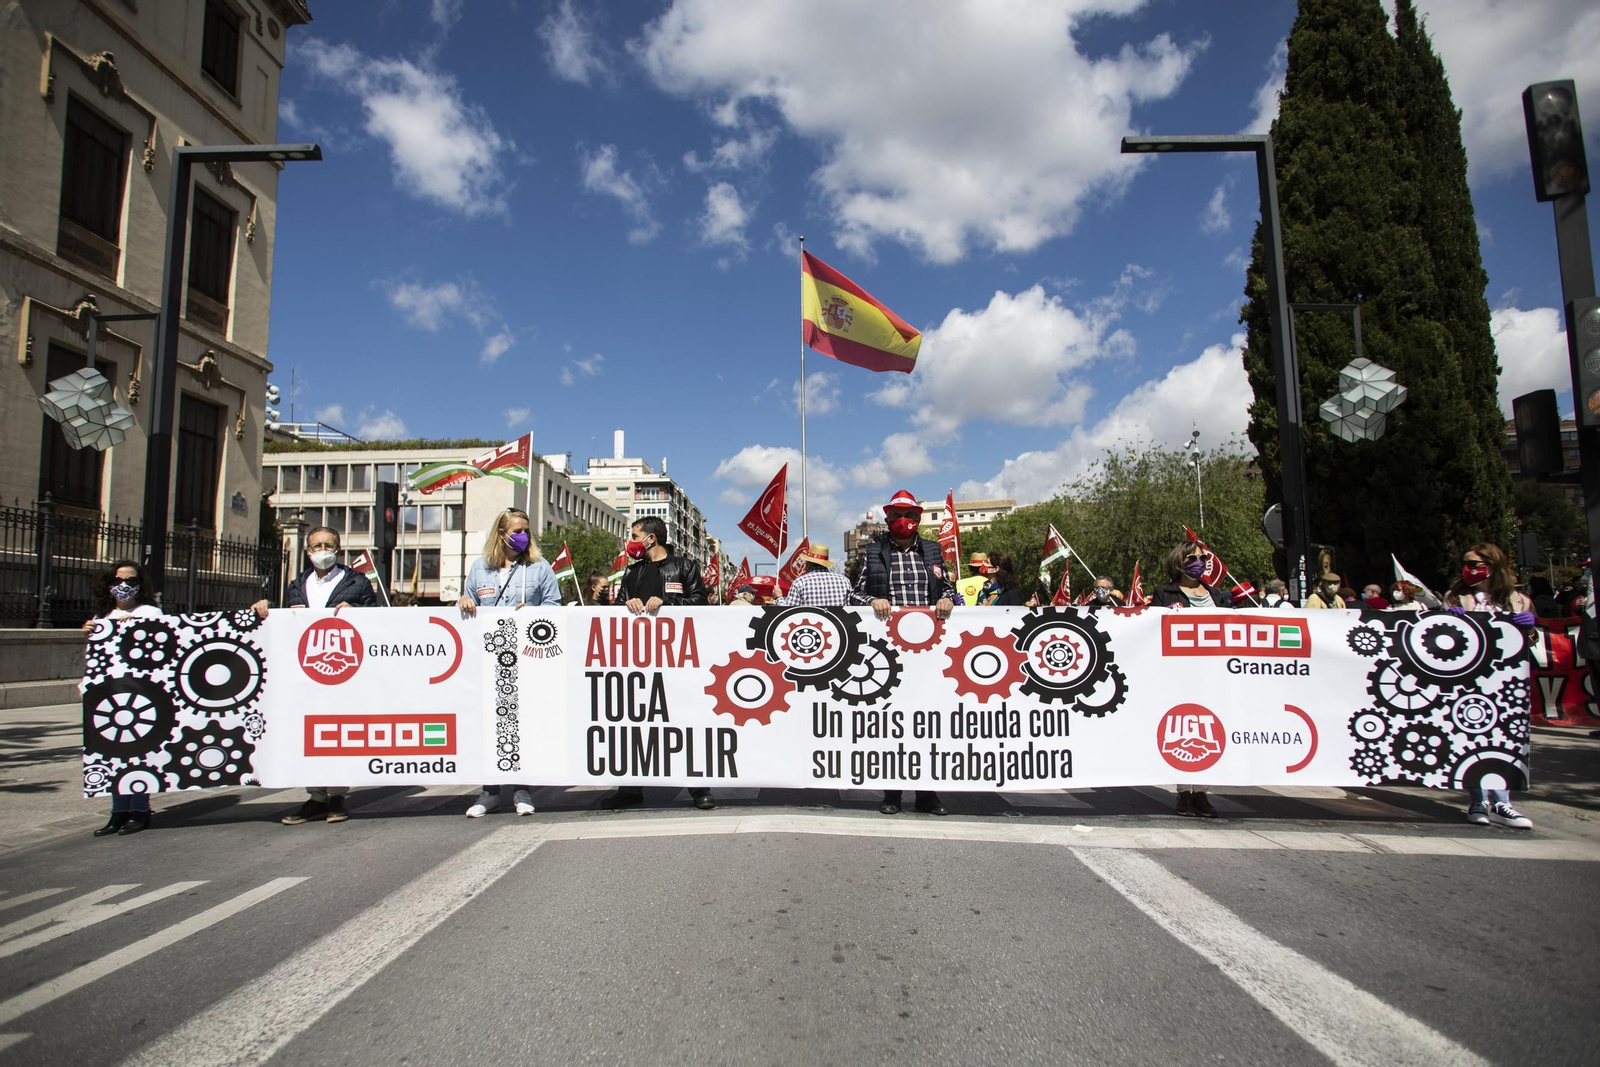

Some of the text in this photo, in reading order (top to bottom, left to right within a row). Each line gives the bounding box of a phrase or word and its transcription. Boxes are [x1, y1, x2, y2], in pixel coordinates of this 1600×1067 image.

[306, 629, 355, 656] UGT
[585, 617, 700, 668] AHORA
[1170, 623, 1275, 648] CCOO
[368, 644, 447, 657] GRANADA
[522, 644, 563, 659] MAYO 2021
[1226, 657, 1311, 676] Granada
[585, 671, 670, 722] TOCA
[314, 723, 420, 748] CCOO
[812, 701, 1070, 744] Un país en deuda con
[1164, 714, 1215, 742] UGT
[1231, 731, 1303, 745] GRANADA
[587, 725, 739, 778] CUMPLIR
[812, 741, 1073, 787] su gente trabajadora
[368, 757, 457, 775] Granada
